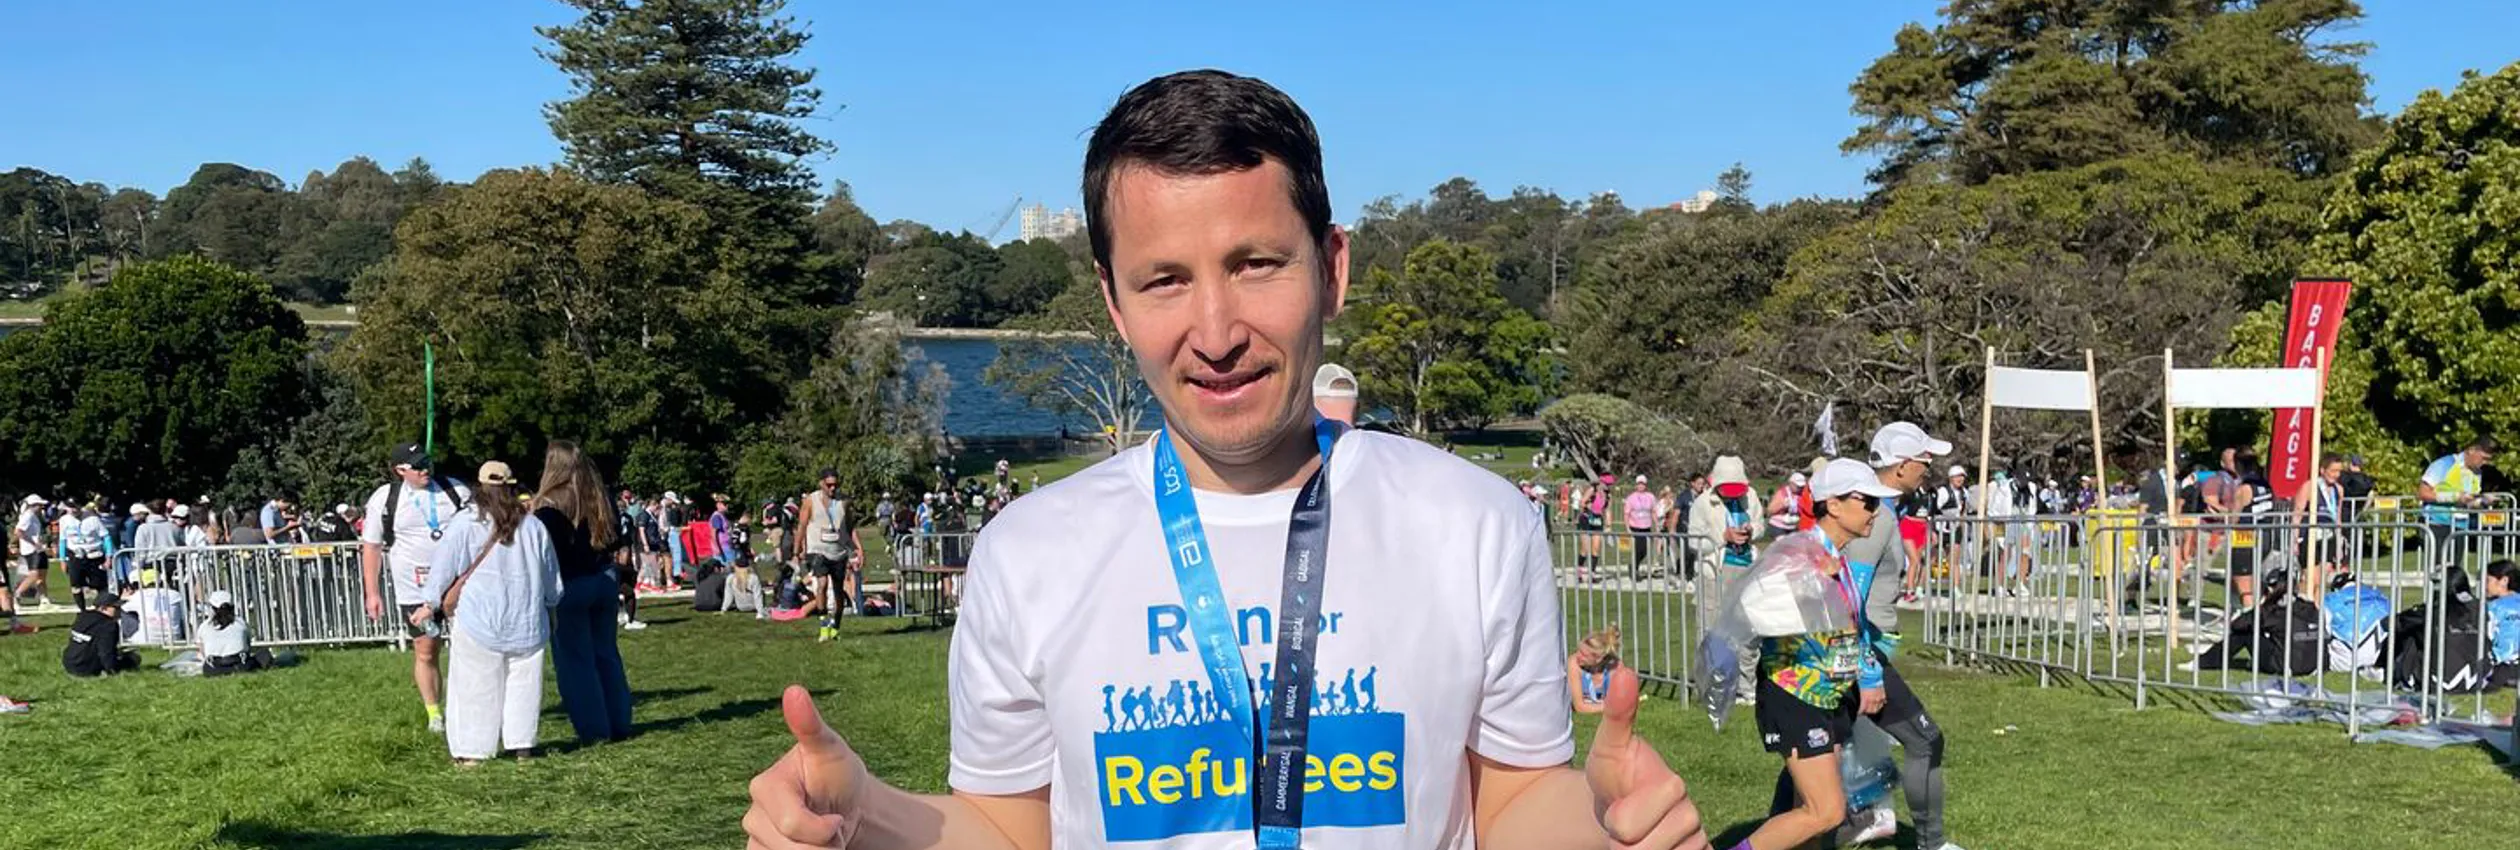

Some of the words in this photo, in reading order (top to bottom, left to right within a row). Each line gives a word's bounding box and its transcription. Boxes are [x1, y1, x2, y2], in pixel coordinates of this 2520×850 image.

[1147, 604, 1272, 655] Rn
[1317, 611, 1343, 634] or
[1105, 748, 1397, 806] Refuees
